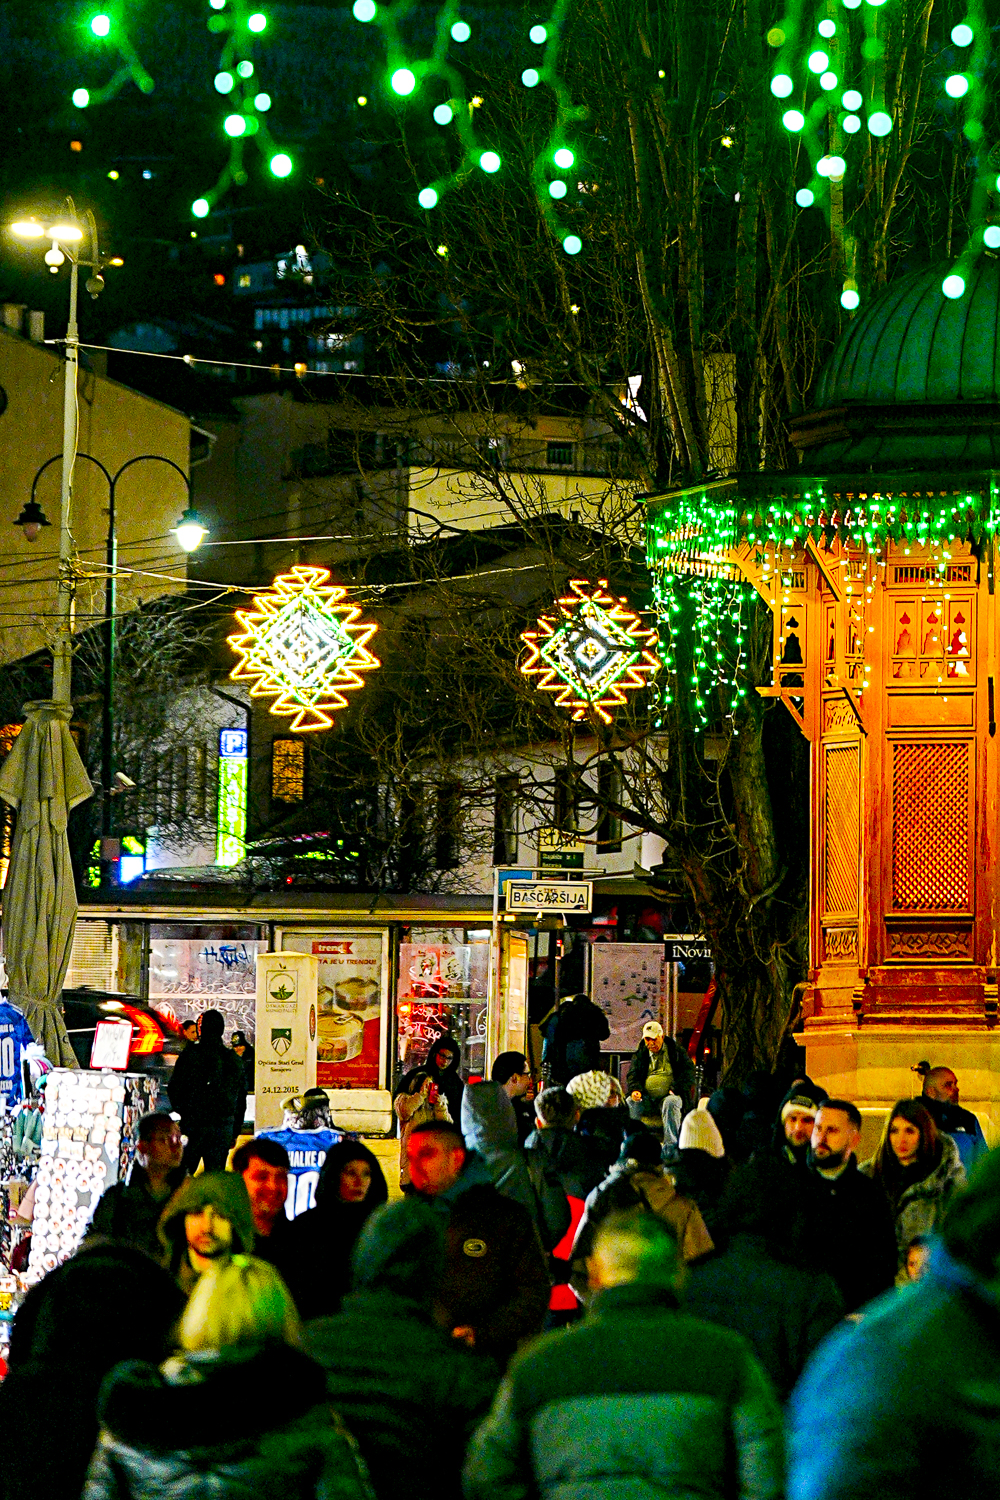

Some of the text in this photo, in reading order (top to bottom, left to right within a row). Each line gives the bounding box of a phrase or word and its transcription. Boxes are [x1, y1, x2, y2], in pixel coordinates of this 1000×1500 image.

[227, 734, 242, 753] P
[513, 889, 586, 905] BAŠČARŠIJA
[318, 943, 344, 952] trend
[262, 1086, 299, 1094] 24.12.2015
